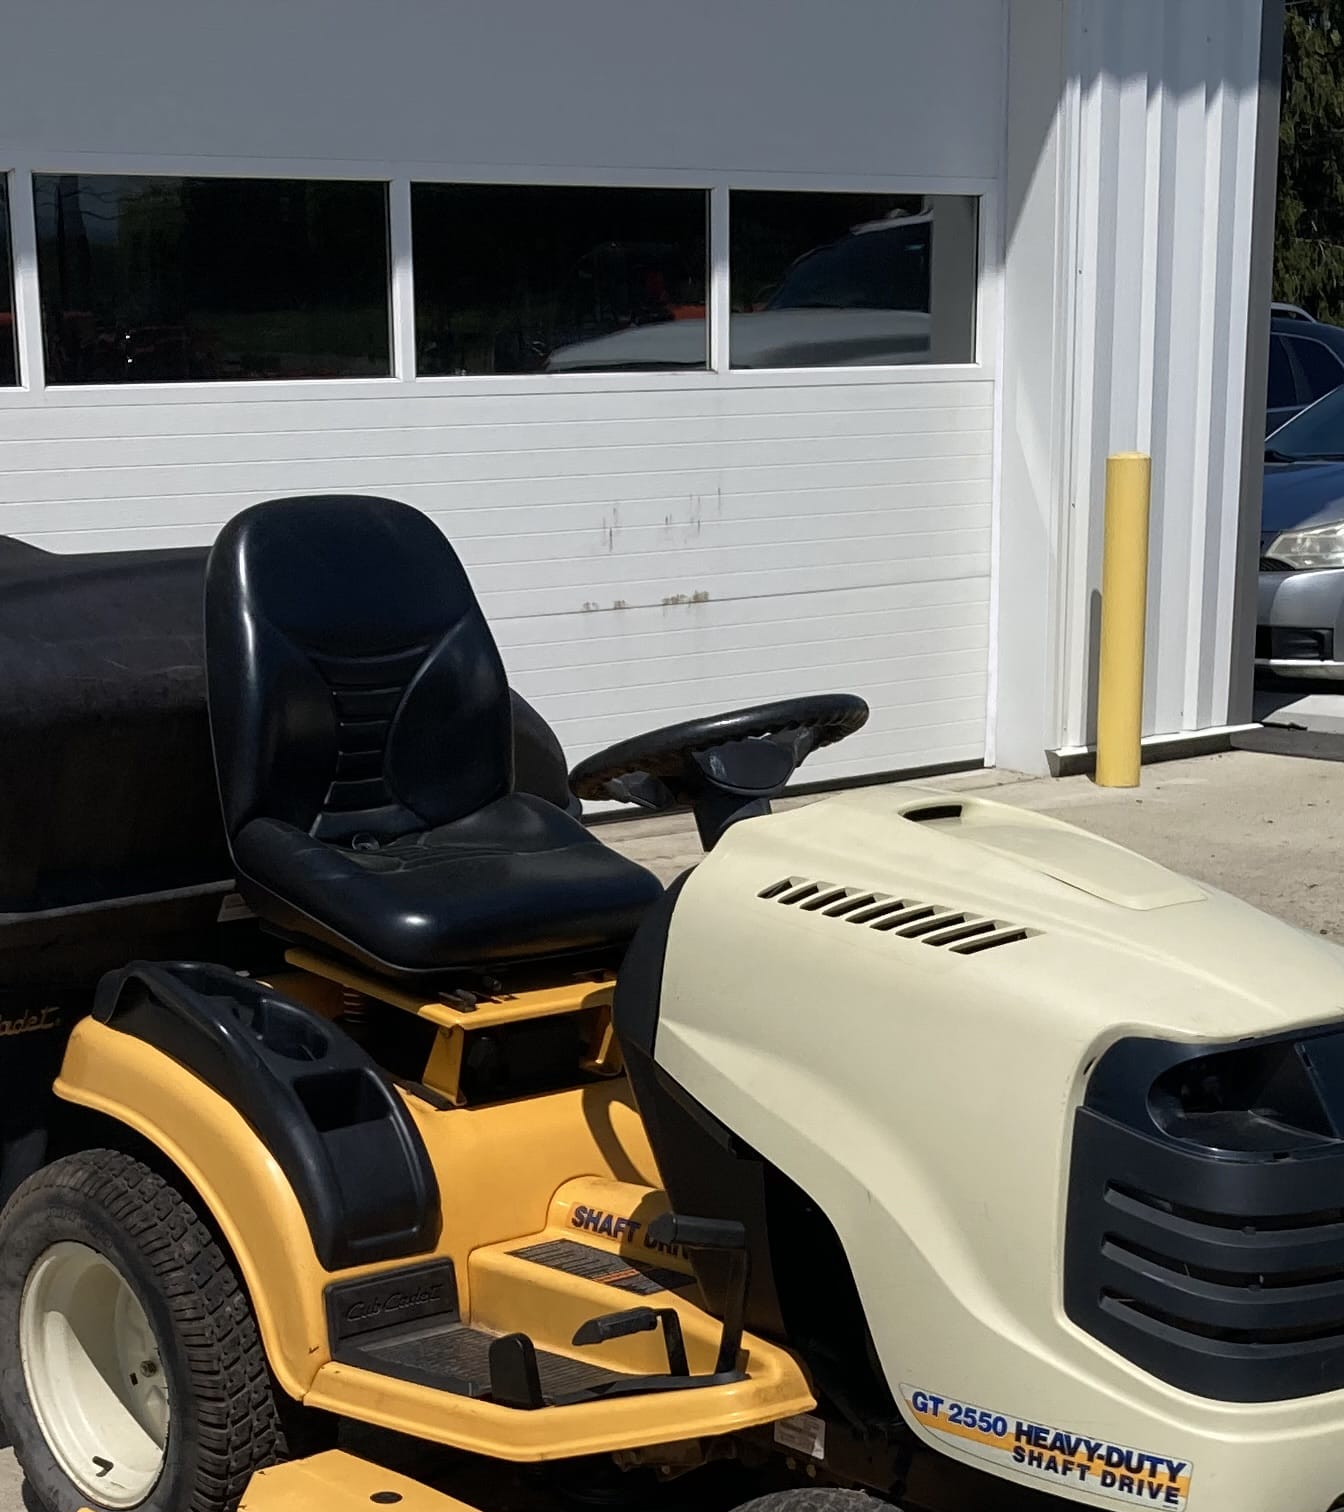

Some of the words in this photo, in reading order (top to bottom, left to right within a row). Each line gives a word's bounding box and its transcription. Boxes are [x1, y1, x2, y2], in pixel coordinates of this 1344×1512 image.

[571, 1205, 642, 1242] SHAFT
[912, 1391, 945, 1417] GT
[948, 1403, 1008, 1438] 2550
[1014, 1421, 1188, 1484] HEAVY-DUTY
[1011, 1446, 1091, 1482] SHAFT
[1100, 1470, 1181, 1505] DRIVE
